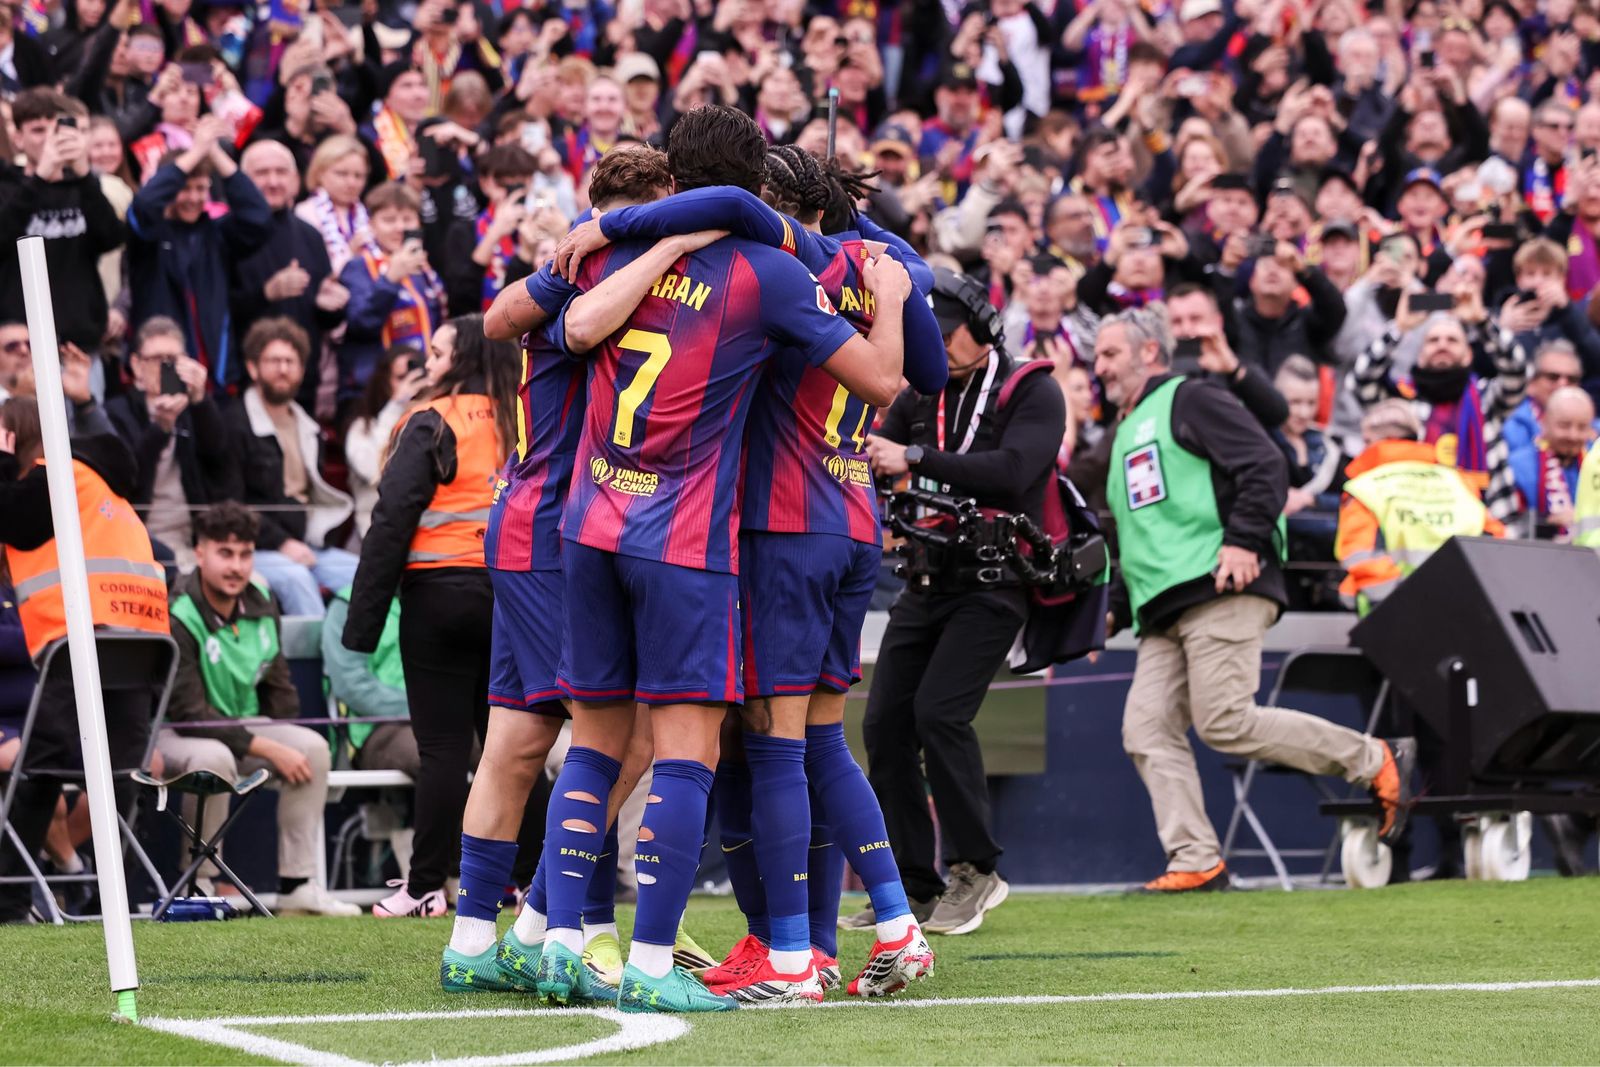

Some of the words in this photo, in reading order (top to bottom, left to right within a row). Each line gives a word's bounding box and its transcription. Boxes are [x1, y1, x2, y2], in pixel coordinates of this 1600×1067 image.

[649, 273, 712, 312] RRAN
[612, 328, 672, 449] 7
[610, 478, 657, 494] ACNUR
[616, 467, 660, 486] UNHCR
